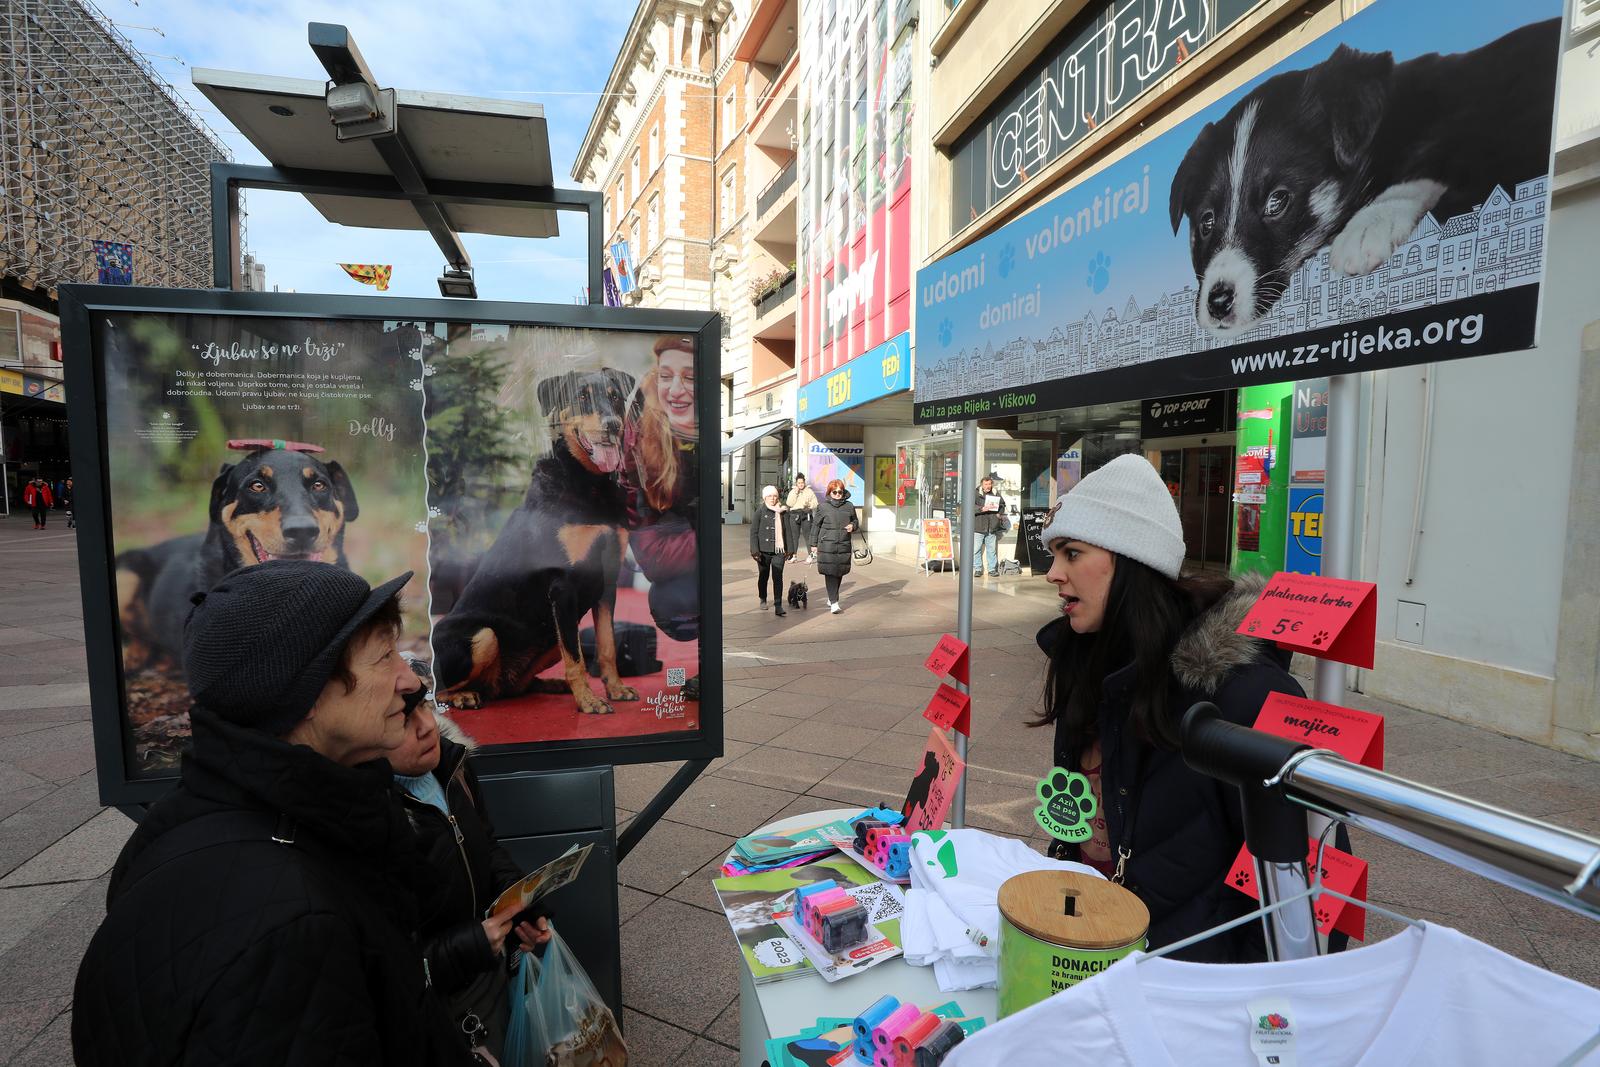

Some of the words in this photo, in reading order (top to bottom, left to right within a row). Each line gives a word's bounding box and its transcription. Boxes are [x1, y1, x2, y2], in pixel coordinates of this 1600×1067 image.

[1025, 164, 1150, 260] volontiraj
[923, 253, 985, 307] udomi
[979, 283, 1041, 330] doniraj
[261, 344, 278, 359] se
[282, 343, 301, 357] ne
[1231, 313, 1484, 375] www.zz-rijeka.org
[882, 354, 899, 378] TEDi
[175, 370, 195, 379] Dolly
[197, 371, 204, 379] je
[206, 370, 255, 378] dobermanica.
[257, 371, 305, 379] Dobermanica
[306, 373, 321, 381] koja
[322, 373, 329, 381] je
[331, 373, 362, 382] kupljena,
[208, 381, 235, 389] voljena.
[238, 381, 267, 389] Usprkos
[264, 391, 287, 399] ljubav,
[300, 391, 320, 400] kupuj
[827, 367, 851, 408] TEDi
[242, 402, 265, 411] Ljubav
[920, 406, 935, 418] Azil
[937, 407, 946, 416] za
[947, 405, 962, 418] pse
[964, 399, 990, 415] Rijeka
[999, 393, 1037, 409] Viškovo
[1163, 402, 1180, 415] TOP
[1180, 398, 1211, 412] SPORT
[347, 416, 397, 442] Dolly
[1320, 592, 1353, 608] torba
[646, 690, 686, 706] udomi
[655, 702, 686, 720] ljubav
[1283, 713, 1341, 737] majica
[1051, 802, 1061, 810] za
[1062, 807, 1077, 817] pse
[1058, 797, 1074, 808] Azil
[1039, 810, 1088, 837] VOLONTER
[770, 940, 791, 964] 2023
[1062, 971, 1083, 981] hranu
